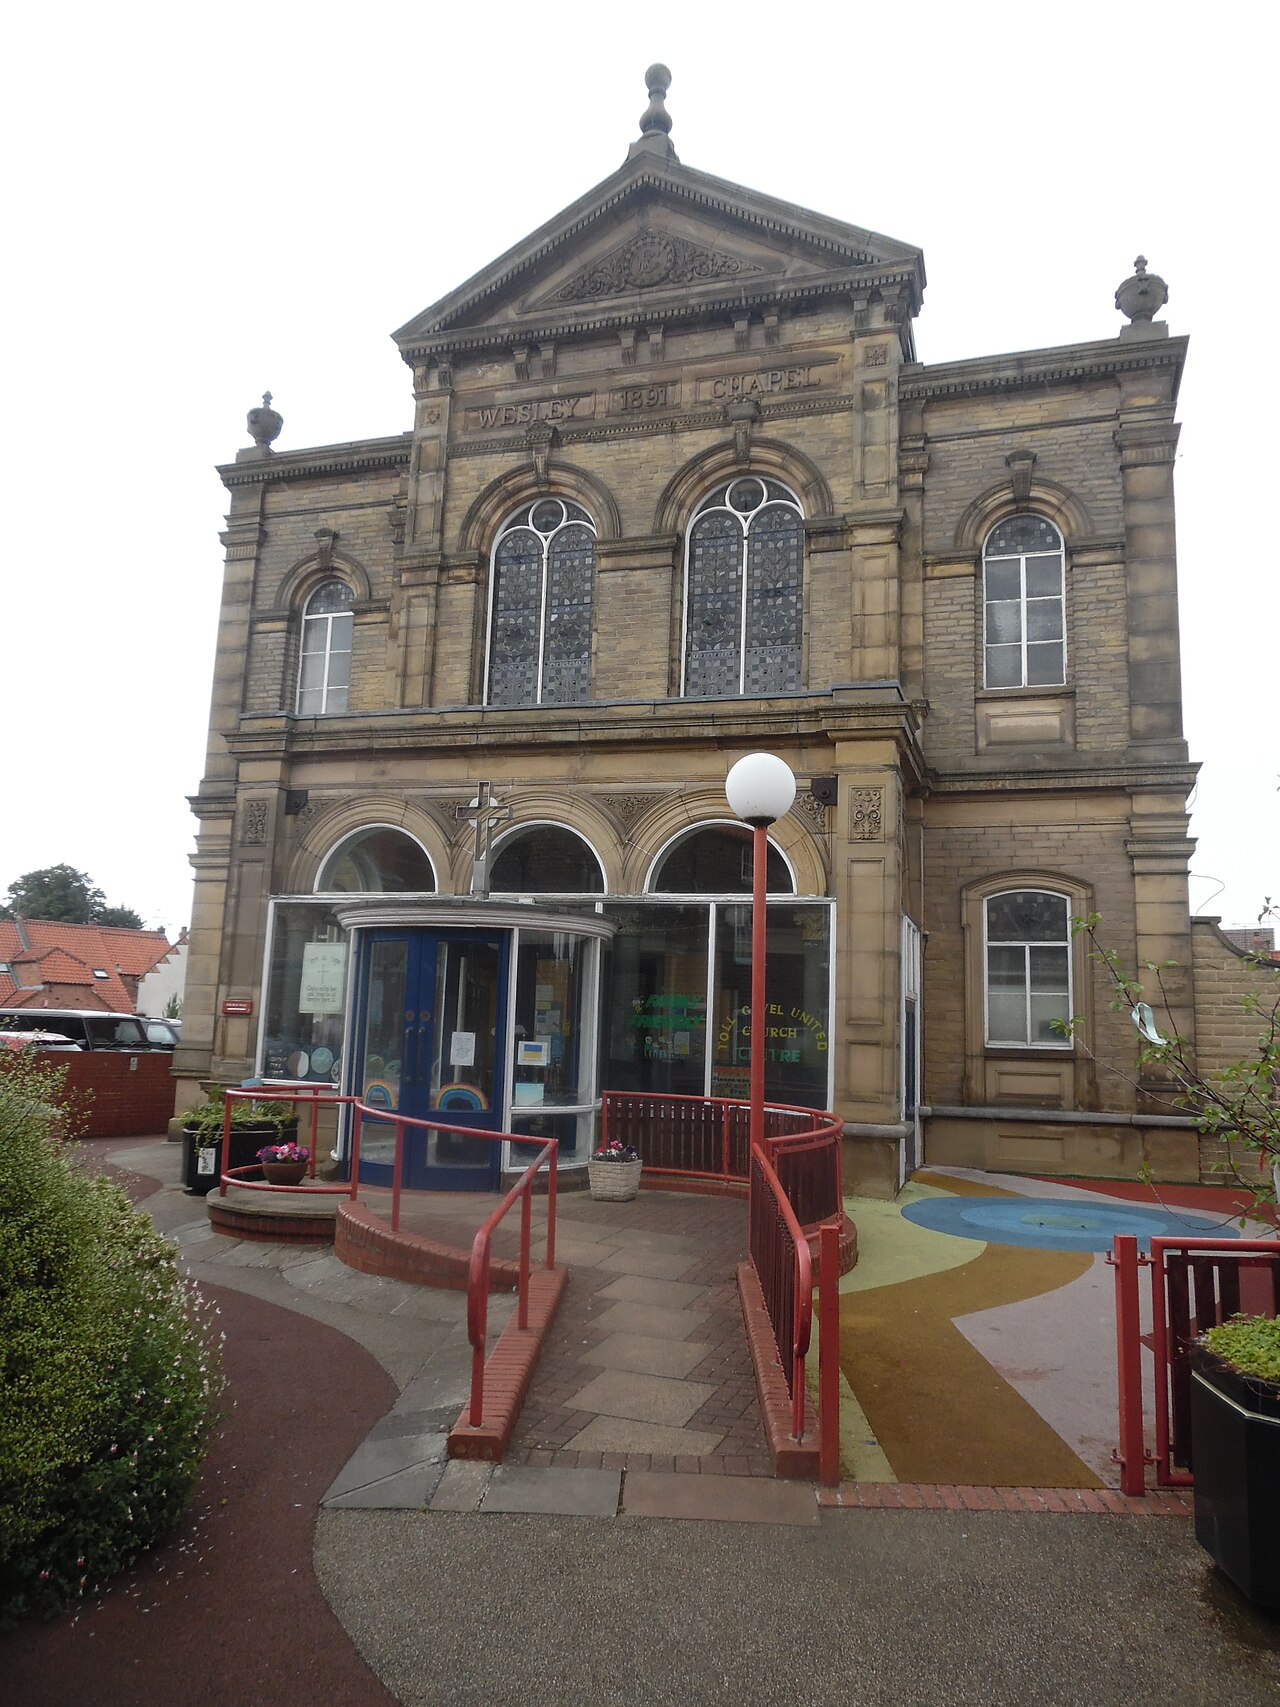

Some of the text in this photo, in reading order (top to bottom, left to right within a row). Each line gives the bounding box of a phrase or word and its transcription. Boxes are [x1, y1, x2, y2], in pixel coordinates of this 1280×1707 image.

[478, 366, 821, 428] WESLEY 1891 CHAPEL
[718, 1016, 736, 1050] TOLL
[741, 1004, 783, 1016] GEL
[790, 1007, 828, 1051] UNITED
[742, 1025, 797, 1039] CRCH
[738, 1047, 801, 1063] CTRE
